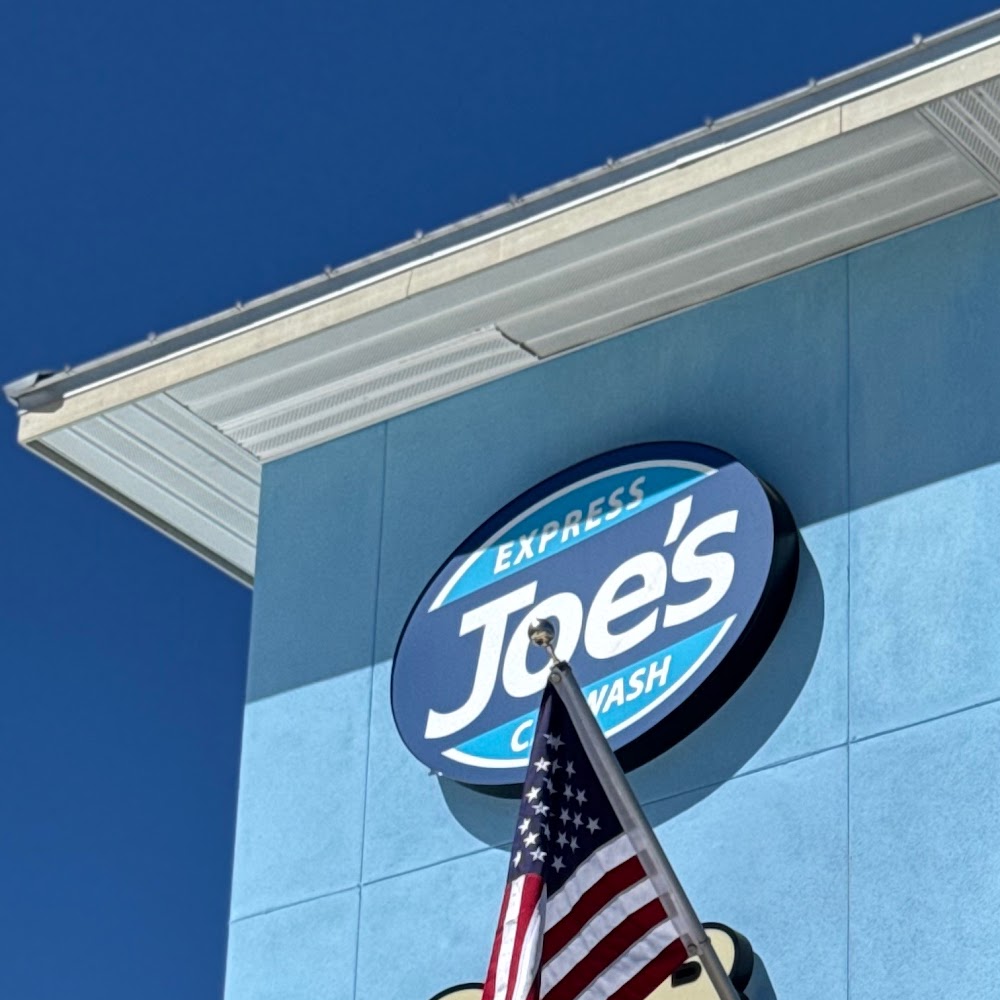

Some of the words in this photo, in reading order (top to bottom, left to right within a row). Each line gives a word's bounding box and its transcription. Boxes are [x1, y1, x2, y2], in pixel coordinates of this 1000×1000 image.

[494, 476, 645, 574] EXPRESS
[424, 495, 738, 739] Joe's
[511, 655, 672, 752] CWASH
